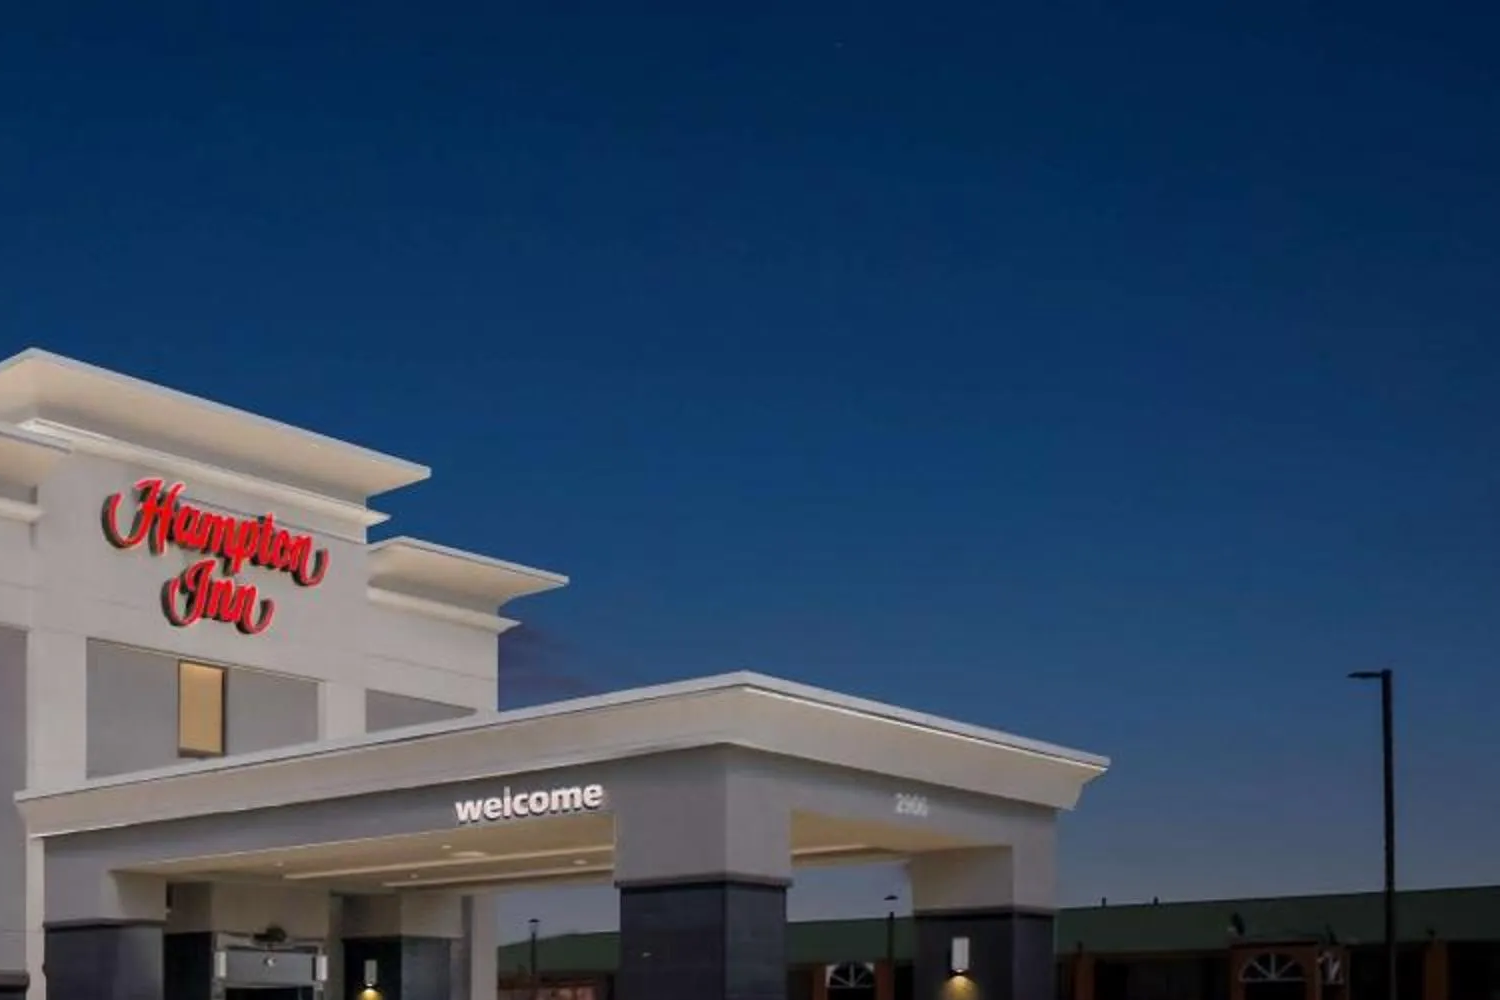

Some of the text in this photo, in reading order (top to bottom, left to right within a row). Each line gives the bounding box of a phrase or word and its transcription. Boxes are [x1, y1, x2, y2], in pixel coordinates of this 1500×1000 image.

[102, 477, 329, 587] Hampton
[161, 559, 274, 634] Inn
[455, 784, 603, 823] welcome
